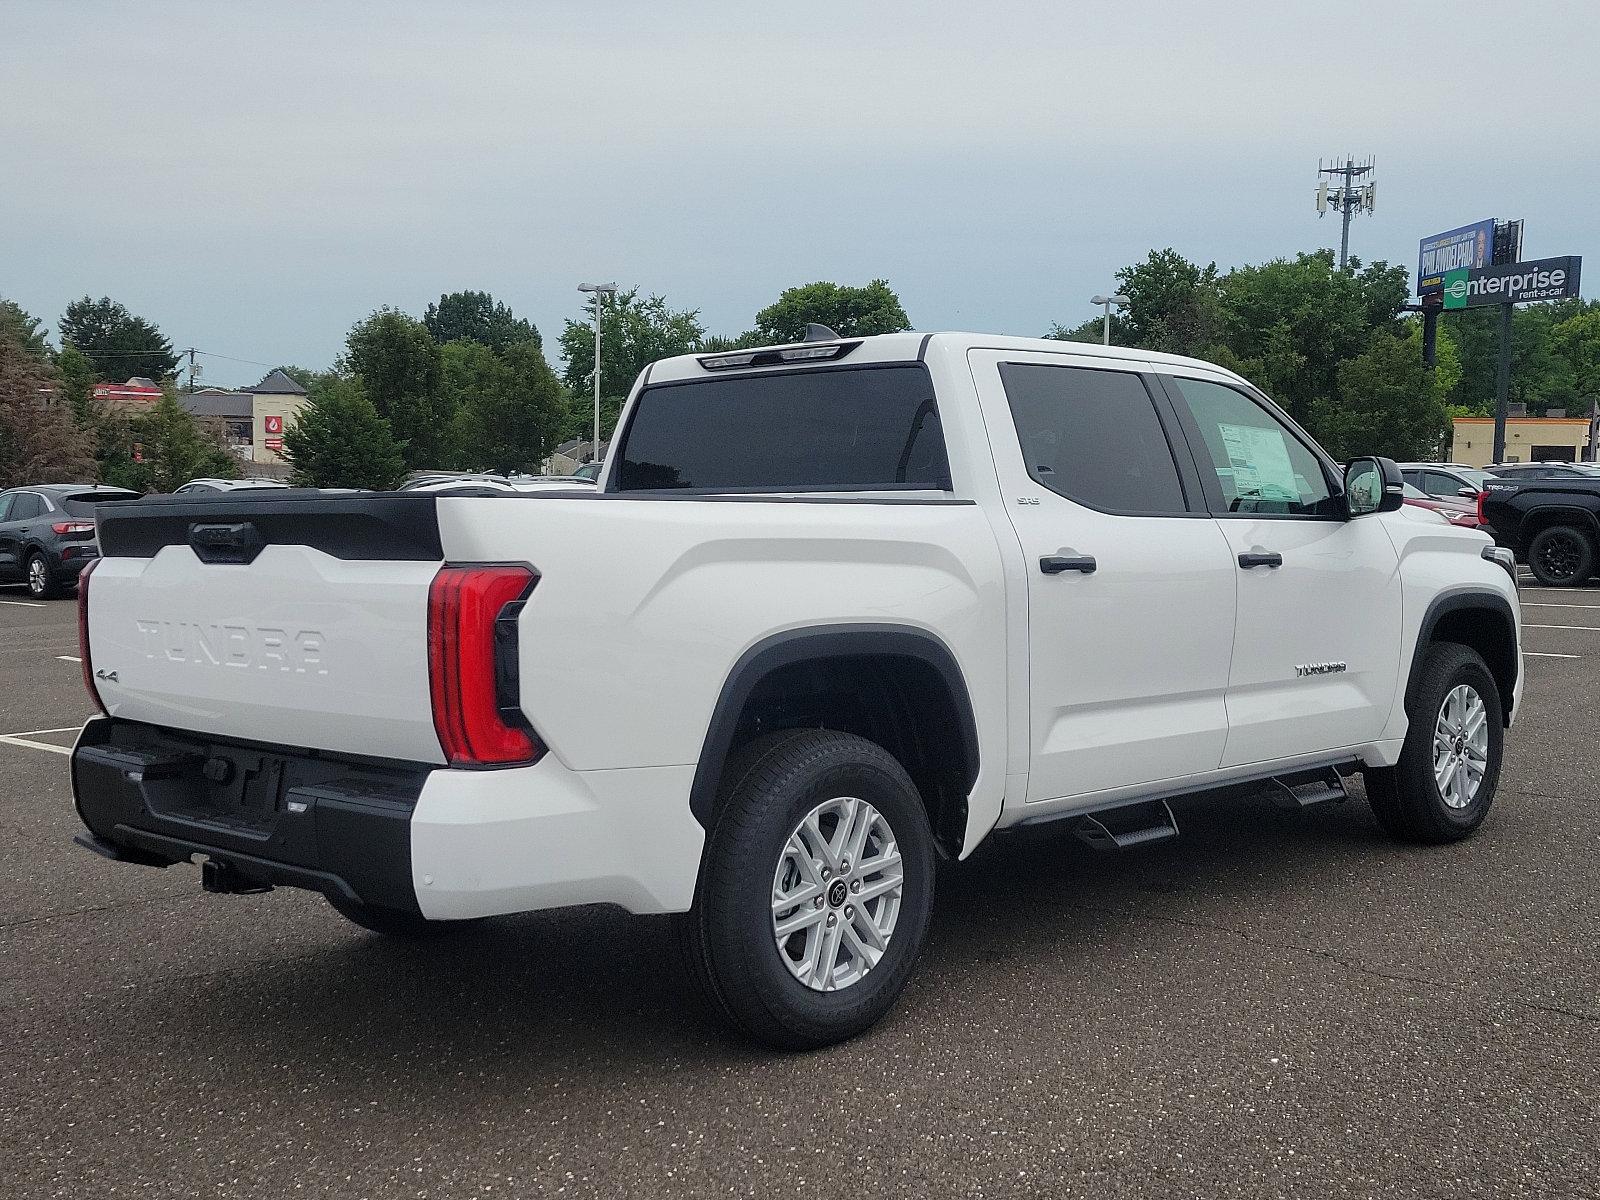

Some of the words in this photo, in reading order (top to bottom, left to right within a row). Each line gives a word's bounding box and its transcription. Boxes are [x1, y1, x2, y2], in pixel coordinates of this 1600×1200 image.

[1444, 267, 1566, 298] enterprise
[1519, 287, 1565, 299] rent-a-car
[136, 619, 329, 675] TUNDRA
